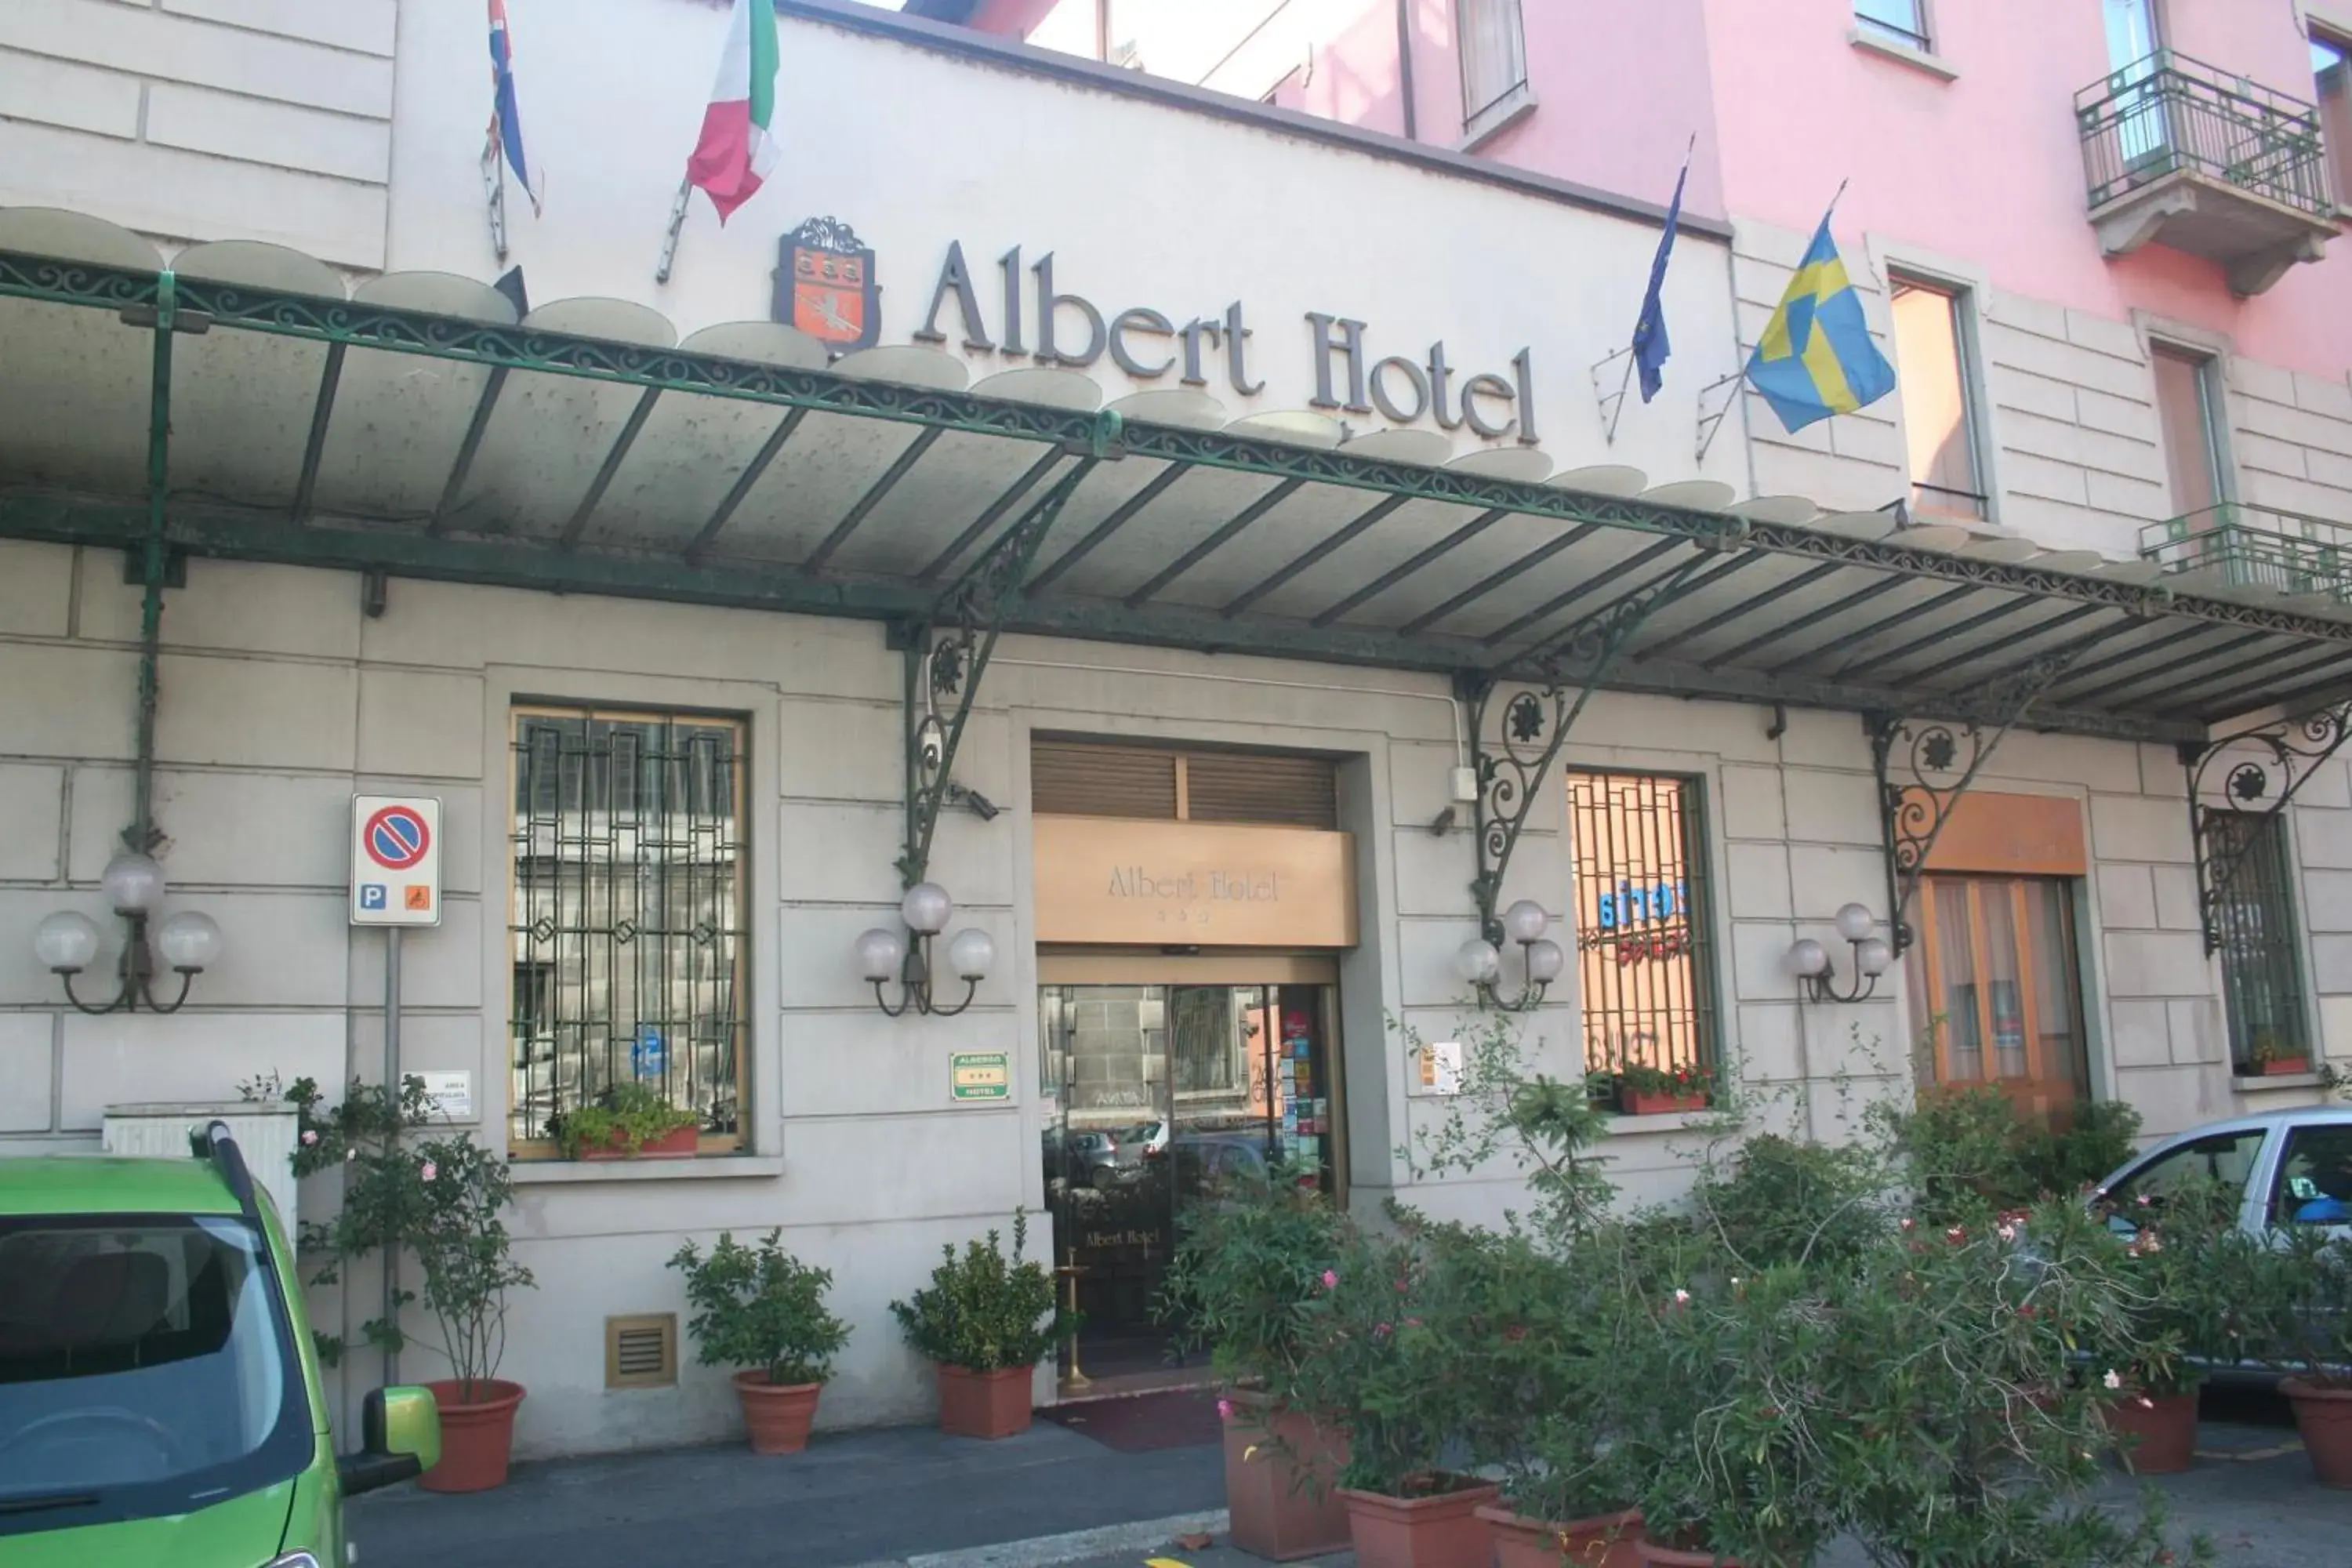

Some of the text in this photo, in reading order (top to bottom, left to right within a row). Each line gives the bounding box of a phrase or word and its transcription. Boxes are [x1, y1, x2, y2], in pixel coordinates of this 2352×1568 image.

[913, 239, 1541, 446] Albert Hotel
[365, 887, 382, 907] P
[1108, 864, 1279, 902] Albert Hotel
[1086, 1231, 1123, 1249] Albert
